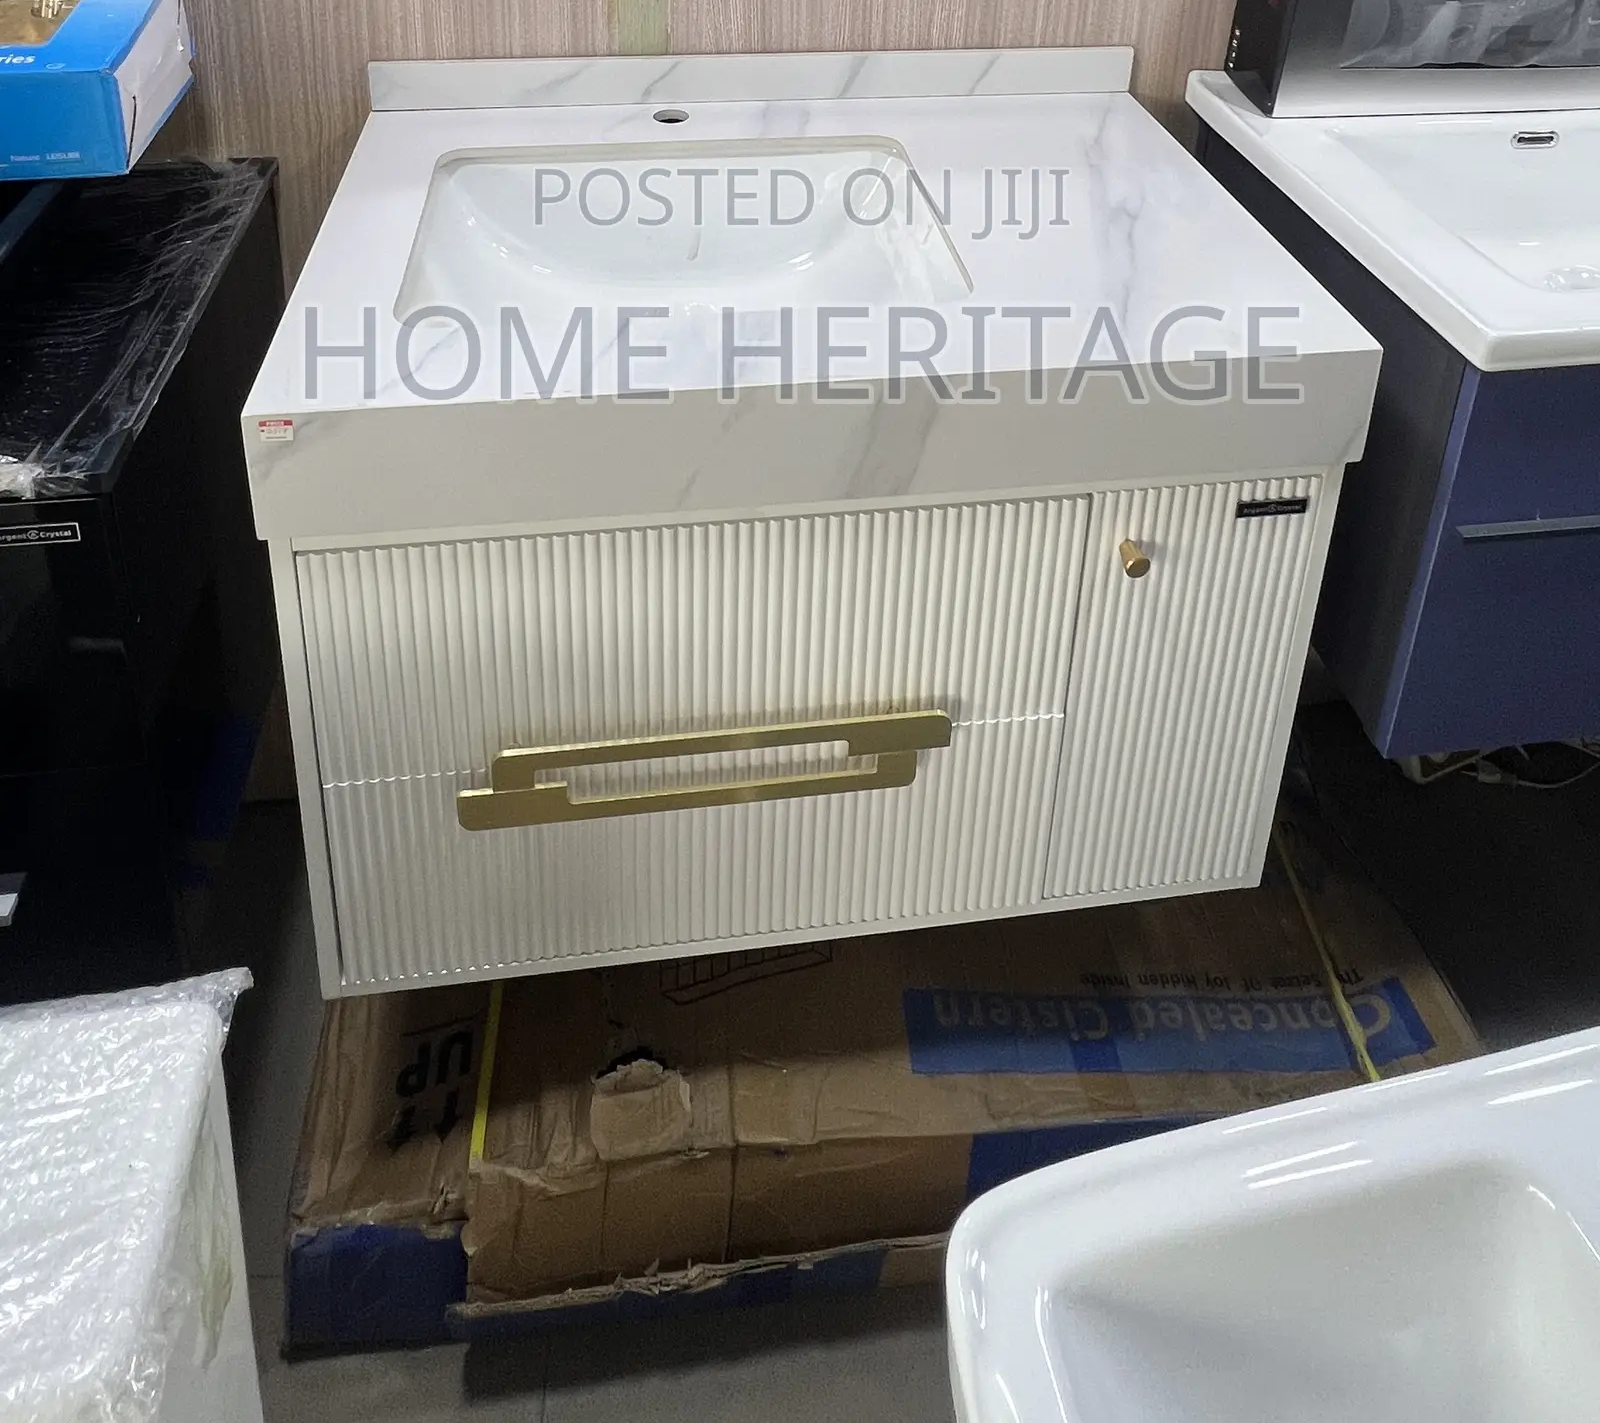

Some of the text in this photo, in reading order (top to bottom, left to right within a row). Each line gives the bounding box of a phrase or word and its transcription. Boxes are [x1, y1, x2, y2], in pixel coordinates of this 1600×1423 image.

[40, 530, 72, 539] Crystal
[933, 992, 1391, 1042] Concealed Cistern
[396, 1031, 474, 1097] UP
